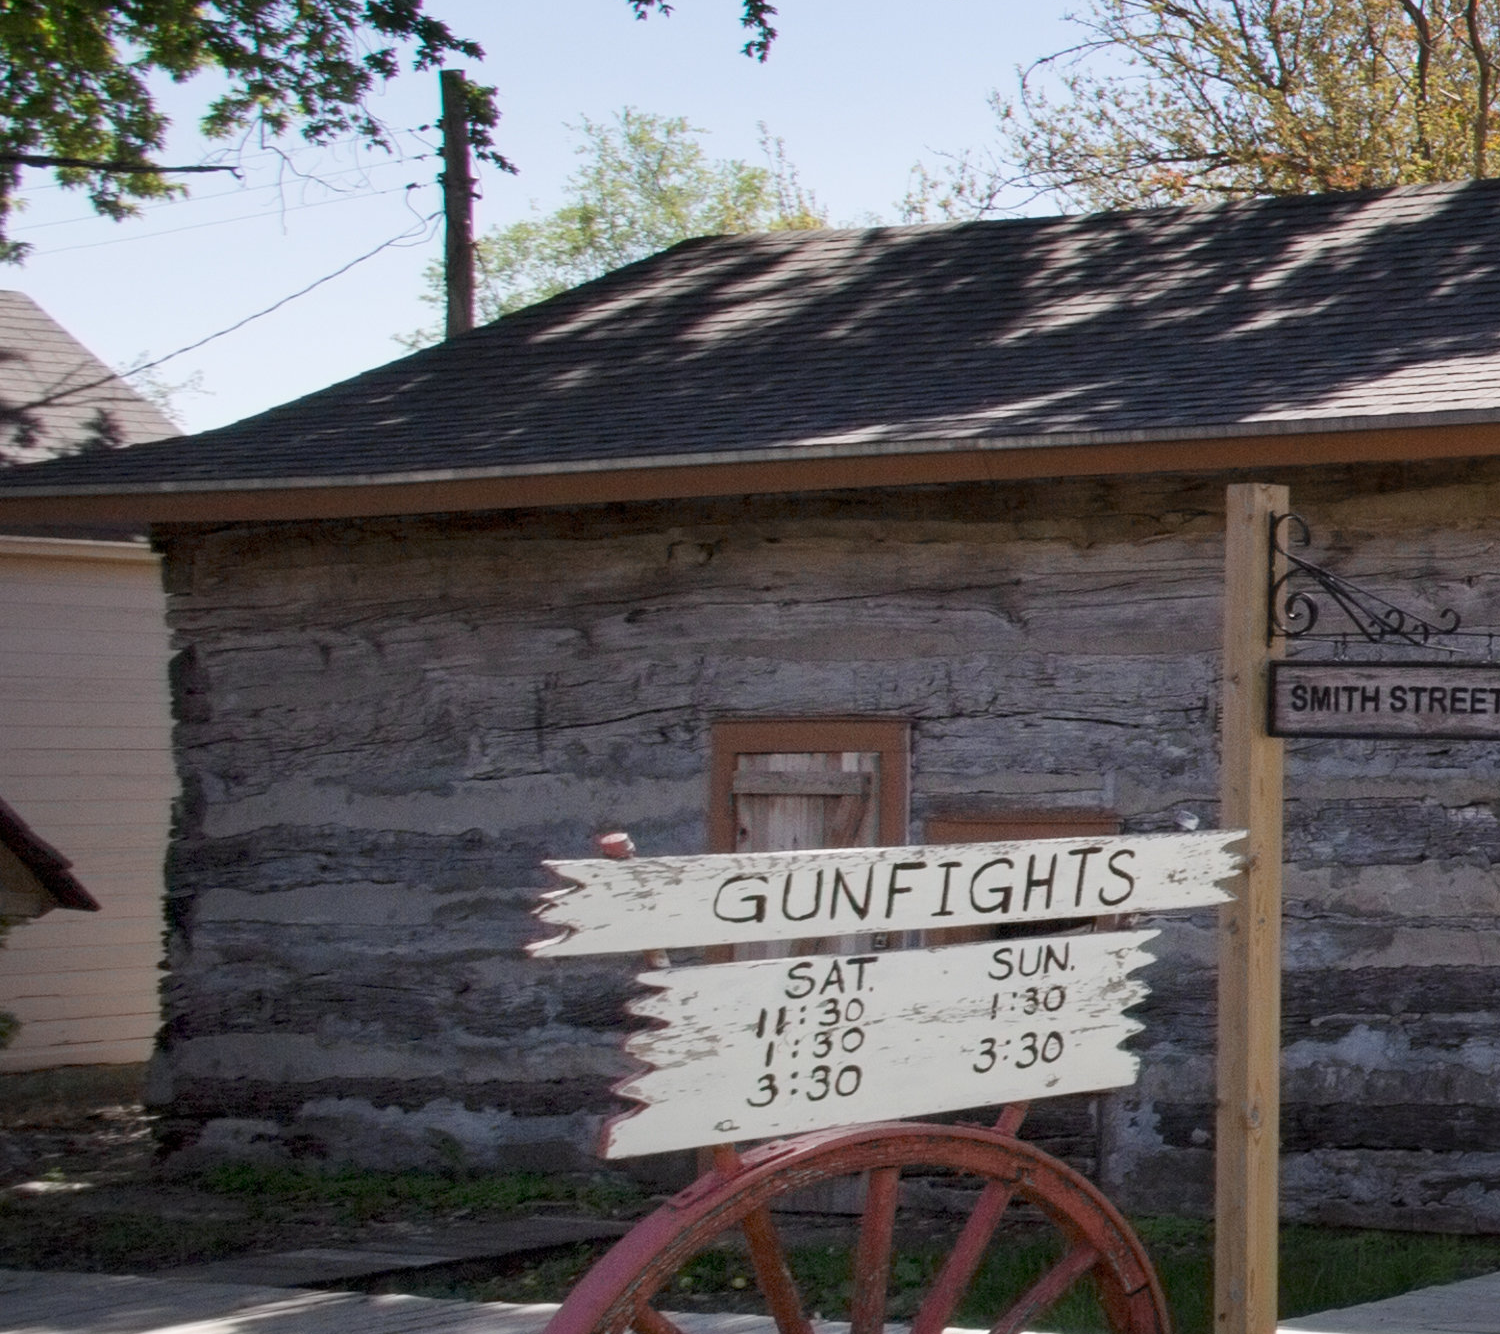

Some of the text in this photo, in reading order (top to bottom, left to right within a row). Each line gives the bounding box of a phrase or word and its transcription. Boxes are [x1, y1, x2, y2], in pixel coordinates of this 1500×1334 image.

[1291, 684, 1380, 713] SMITH
[713, 847, 1136, 924] GUNFIGHTS
[785, 956, 878, 1000] SAT.
[987, 941, 1076, 981] SUN.
[755, 997, 865, 1038] 11:30
[989, 984, 1067, 1020] 1:30
[763, 1028, 865, 1067] 1:30
[972, 1029, 1065, 1075] 3:30
[746, 1066, 862, 1108] 3:30
